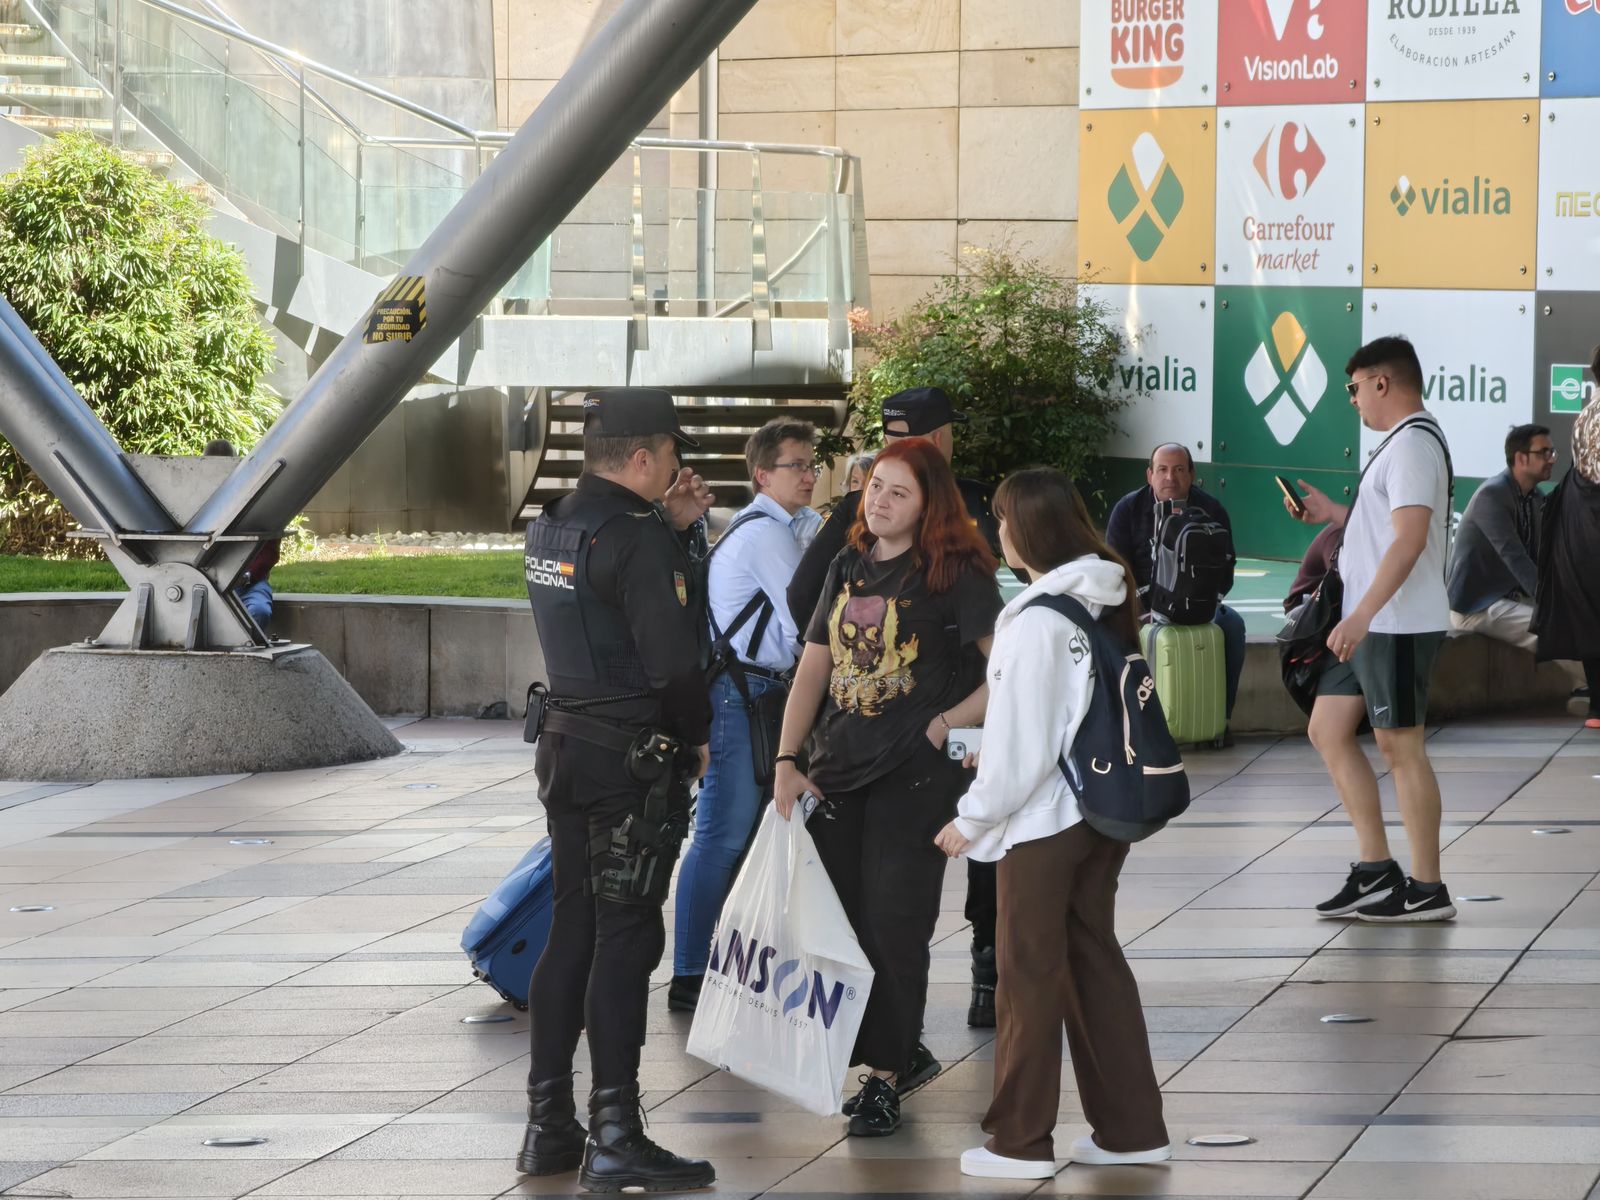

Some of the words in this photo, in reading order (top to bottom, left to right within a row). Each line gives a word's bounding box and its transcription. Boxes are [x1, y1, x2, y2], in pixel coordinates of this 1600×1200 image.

[1111, 0, 1185, 23] BURGER
[1429, 27, 1454, 36] DESDE
[1458, 26, 1476, 35] 1939
[1110, 23, 1185, 64] KING
[1464, 30, 1516, 65] ARTESANA
[1244, 53, 1339, 81] VisionLab
[1421, 175, 1512, 215] vialia
[1243, 214, 1335, 241] Carrefour
[1256, 247, 1320, 273] market
[376, 323, 411, 331] SEGURIDAD
[383, 315, 395, 323] POR
[396, 315, 404, 323] TU
[372, 331, 384, 341] NO
[1119, 355, 1197, 392] vialia
[526, 569, 575, 590] NACIONAL
[748, 997, 778, 1018] DEPUIS
